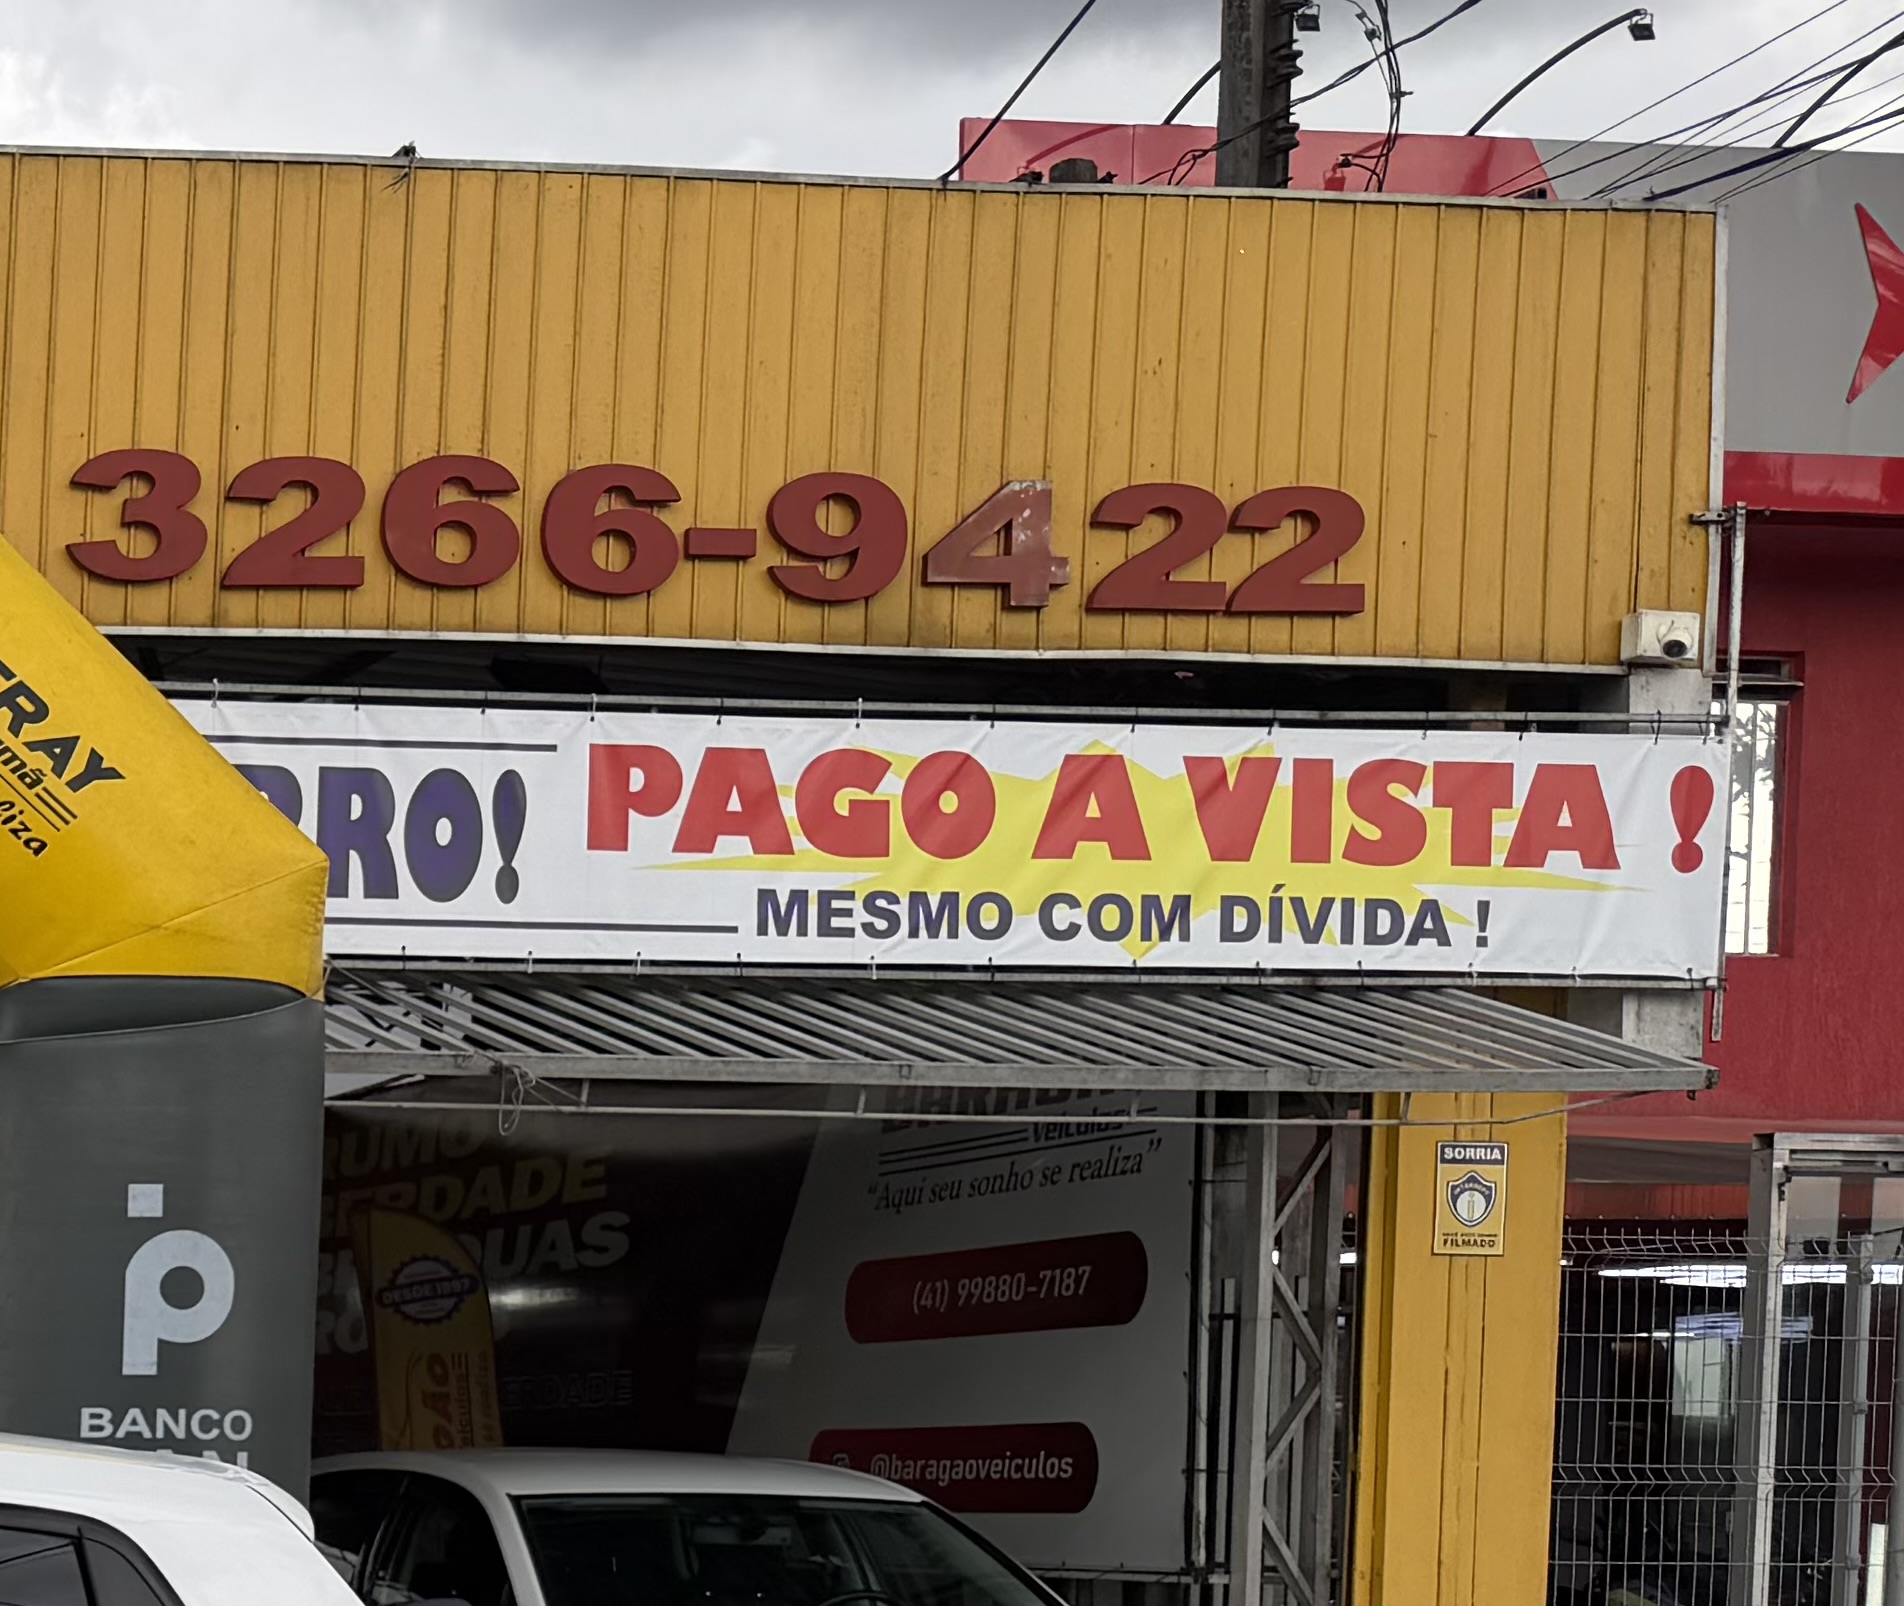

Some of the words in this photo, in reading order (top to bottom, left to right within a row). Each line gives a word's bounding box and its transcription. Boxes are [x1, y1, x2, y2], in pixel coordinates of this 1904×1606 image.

[67, 449, 1365, 616] 3266-9422
[586, 743, 997, 861] PAGO
[1032, 753, 1152, 862] A
[1183, 756, 1622, 871] VISTA
[754, 887, 1026, 942] MESMO
[1038, 892, 1193, 945] COM
[1218, 883, 1450, 949] DÍVIDA
[1444, 1147, 1501, 1160] SORRIA
[928, 1178, 962, 1204] seu
[968, 1161, 1033, 1198] sonho
[1039, 1166, 1062, 1188] se
[1443, 1237, 1496, 1248] FILMADO
[912, 1279, 950, 1317] (41)
[957, 1265, 1093, 1307] 99880-7187
[79, 1406, 253, 1441] BANCO
[869, 1452, 1073, 1487] @baragaoveiculos
